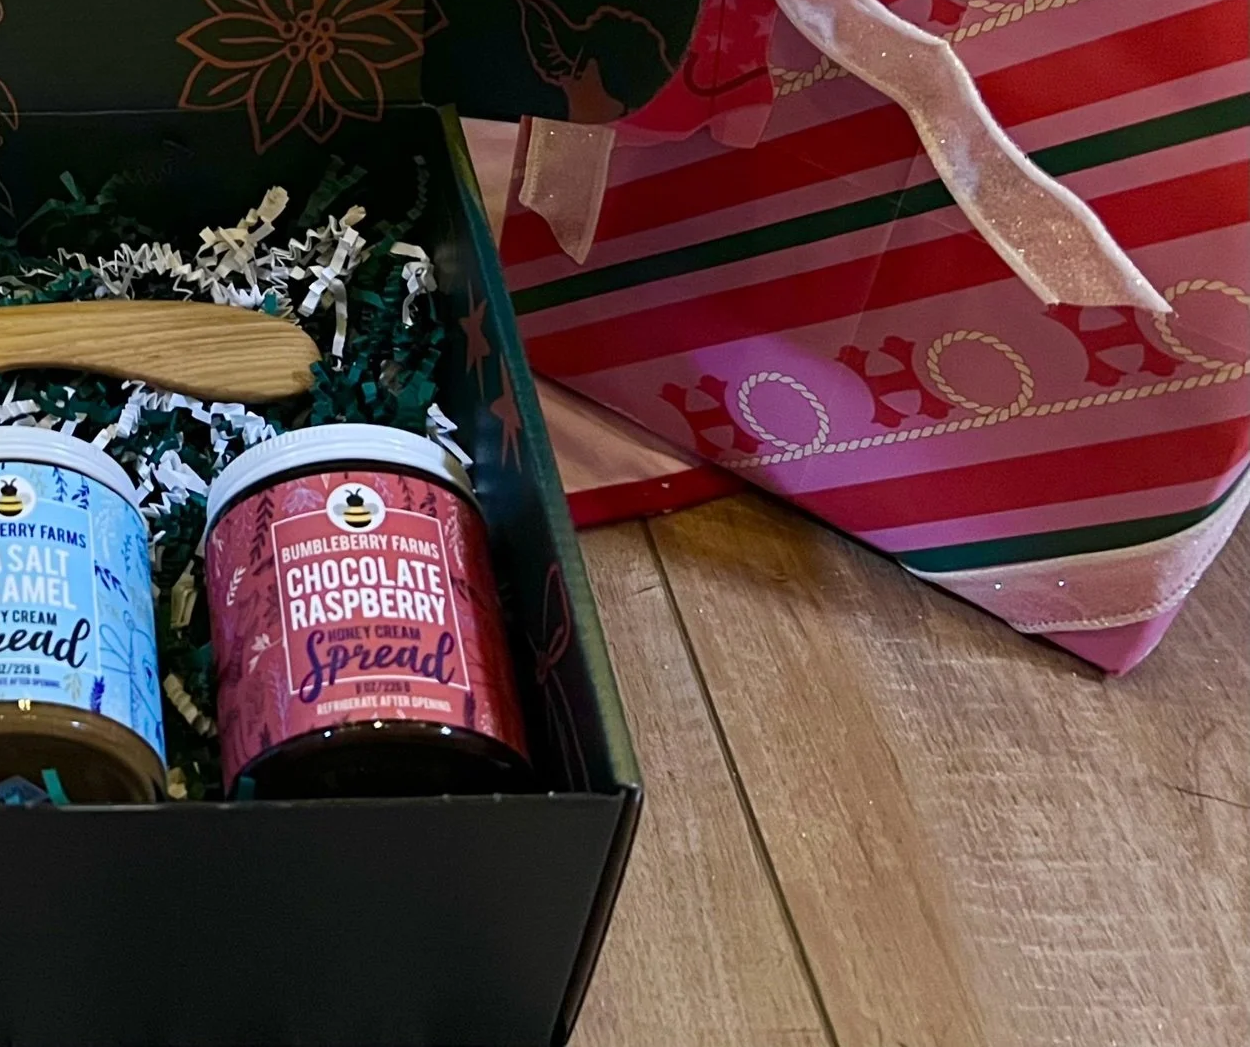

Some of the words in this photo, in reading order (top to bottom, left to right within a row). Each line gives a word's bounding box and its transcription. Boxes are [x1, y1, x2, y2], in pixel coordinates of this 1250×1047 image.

[40, 524, 87, 549] FARMS
[281, 534, 388, 563] BUMBLEBERRY
[392, 536, 439, 560] FARMS
[7, 544, 70, 578] SALT
[286, 556, 444, 598] CHOCOLATE
[13, 610, 58, 626] CREAM
[289, 588, 446, 630] RASPBERRY
[327, 625, 370, 643] HONEY
[375, 625, 421, 640] CREAM
[299, 630, 455, 703] Spread
[317, 696, 377, 715] REFRIGERATE
[380, 695, 410, 707] AFTER
